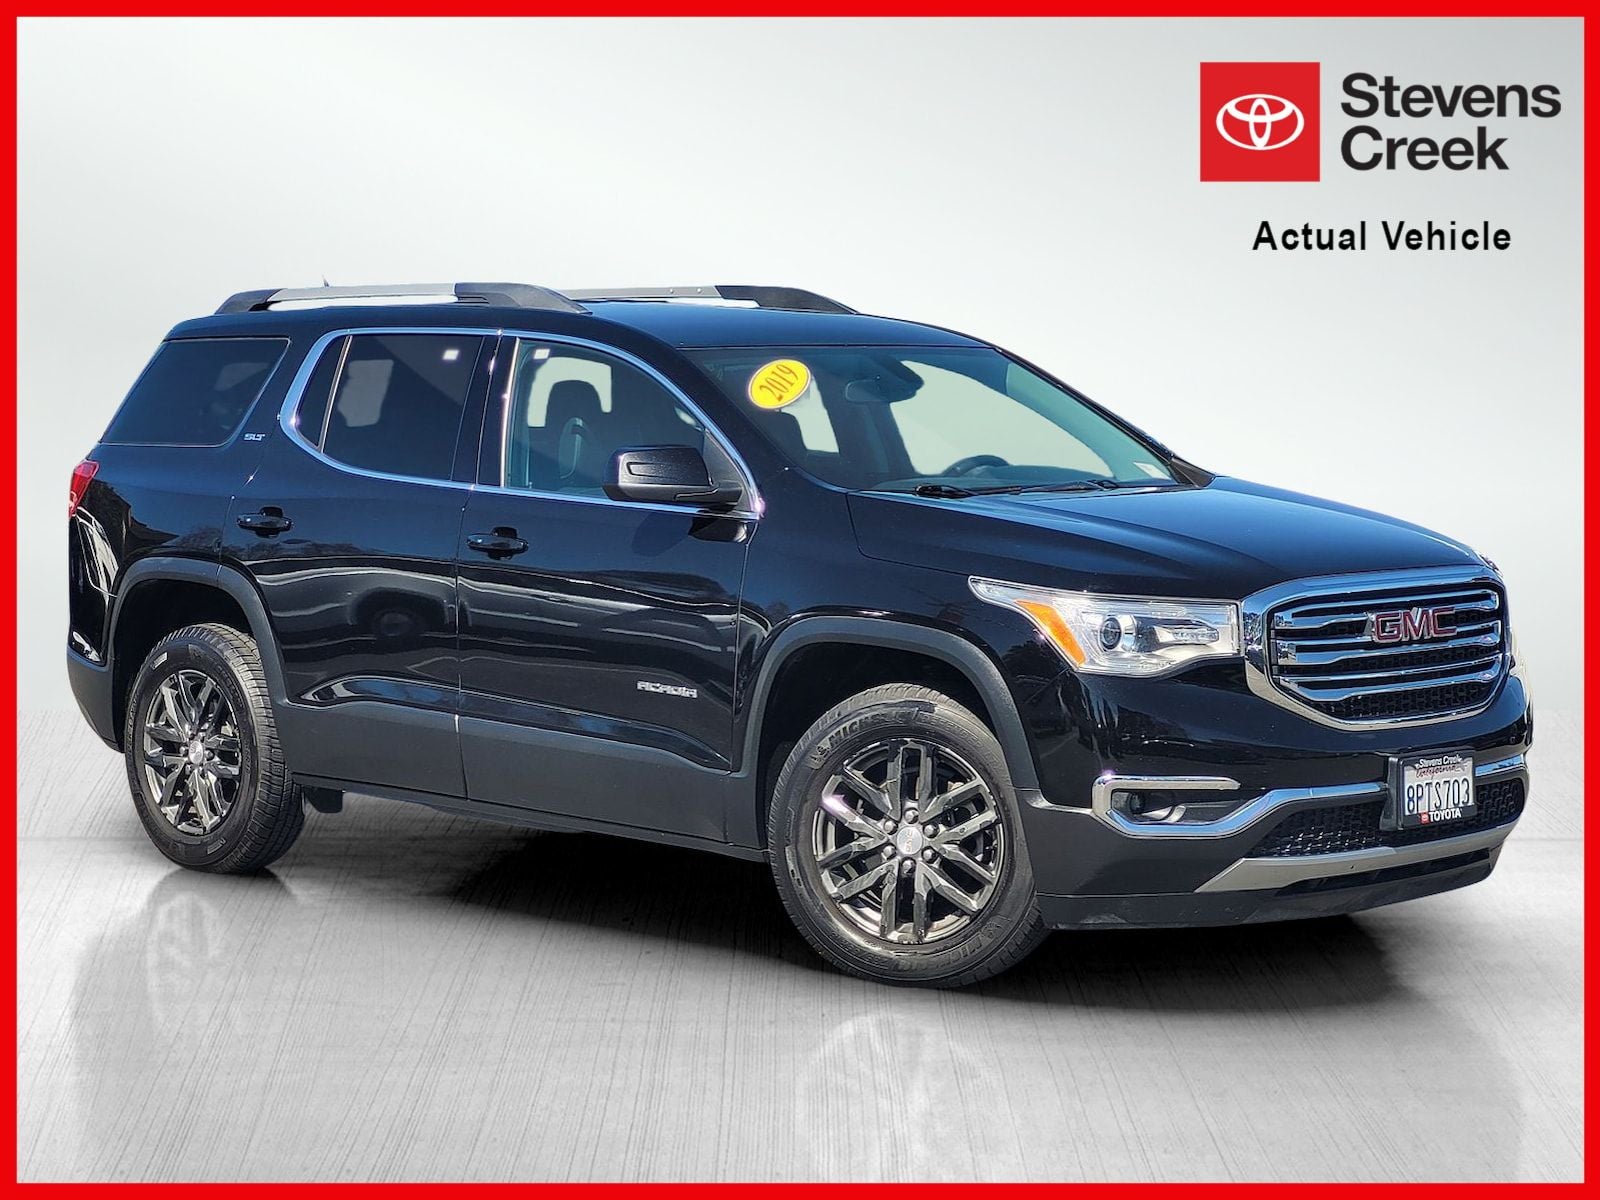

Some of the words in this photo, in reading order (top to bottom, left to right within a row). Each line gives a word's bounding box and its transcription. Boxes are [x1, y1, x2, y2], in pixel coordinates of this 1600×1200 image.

[759, 364, 799, 402] 2019
[244, 433, 266, 441] SLT
[1373, 605, 1458, 643] GMC
[636, 680, 698, 698] ACADIA
[1406, 777, 1470, 814] 8PTS703
[1429, 807, 1462, 822] TOYOTA
